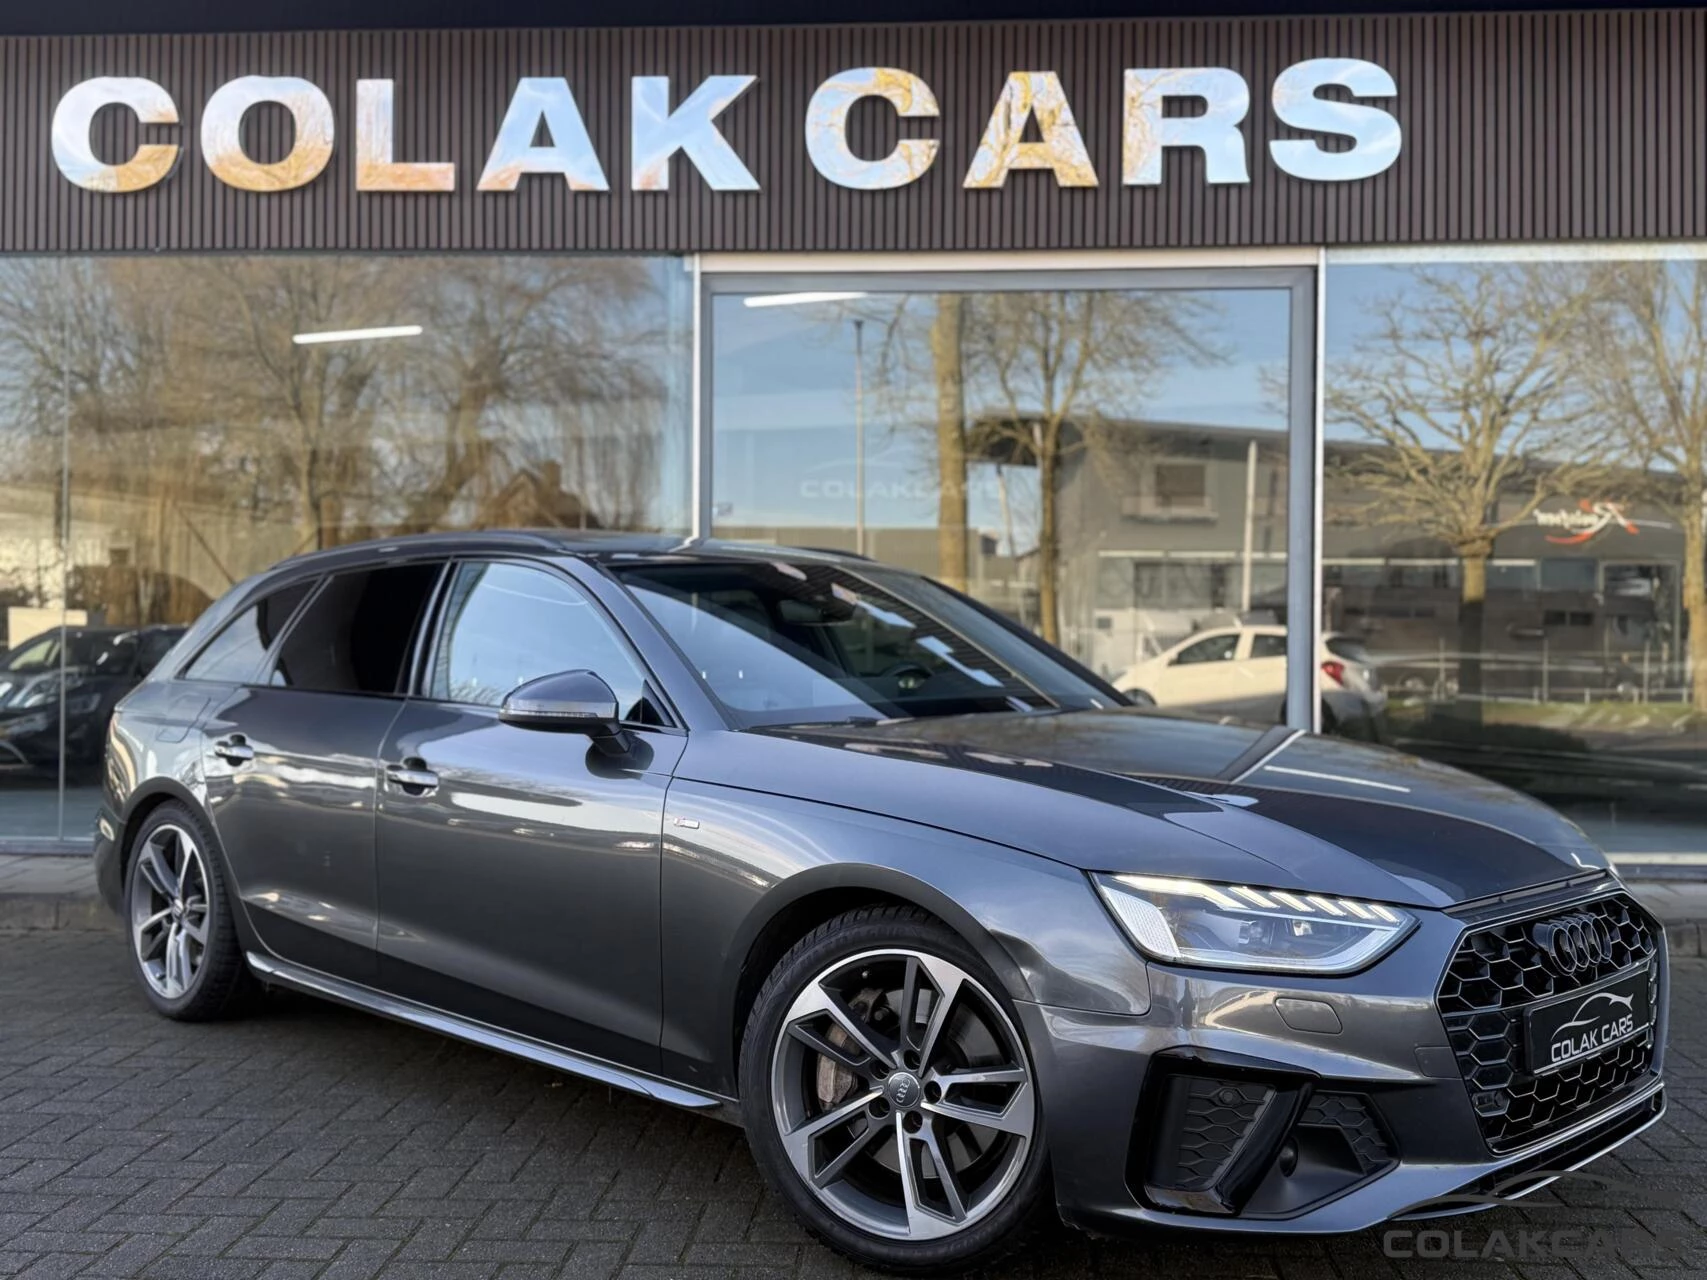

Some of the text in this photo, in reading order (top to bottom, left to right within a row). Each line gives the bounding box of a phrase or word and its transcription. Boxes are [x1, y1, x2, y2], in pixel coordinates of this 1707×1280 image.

[52, 58, 1402, 194] COLAK CARS
[1551, 1014, 1633, 1062] COLAK CARS
